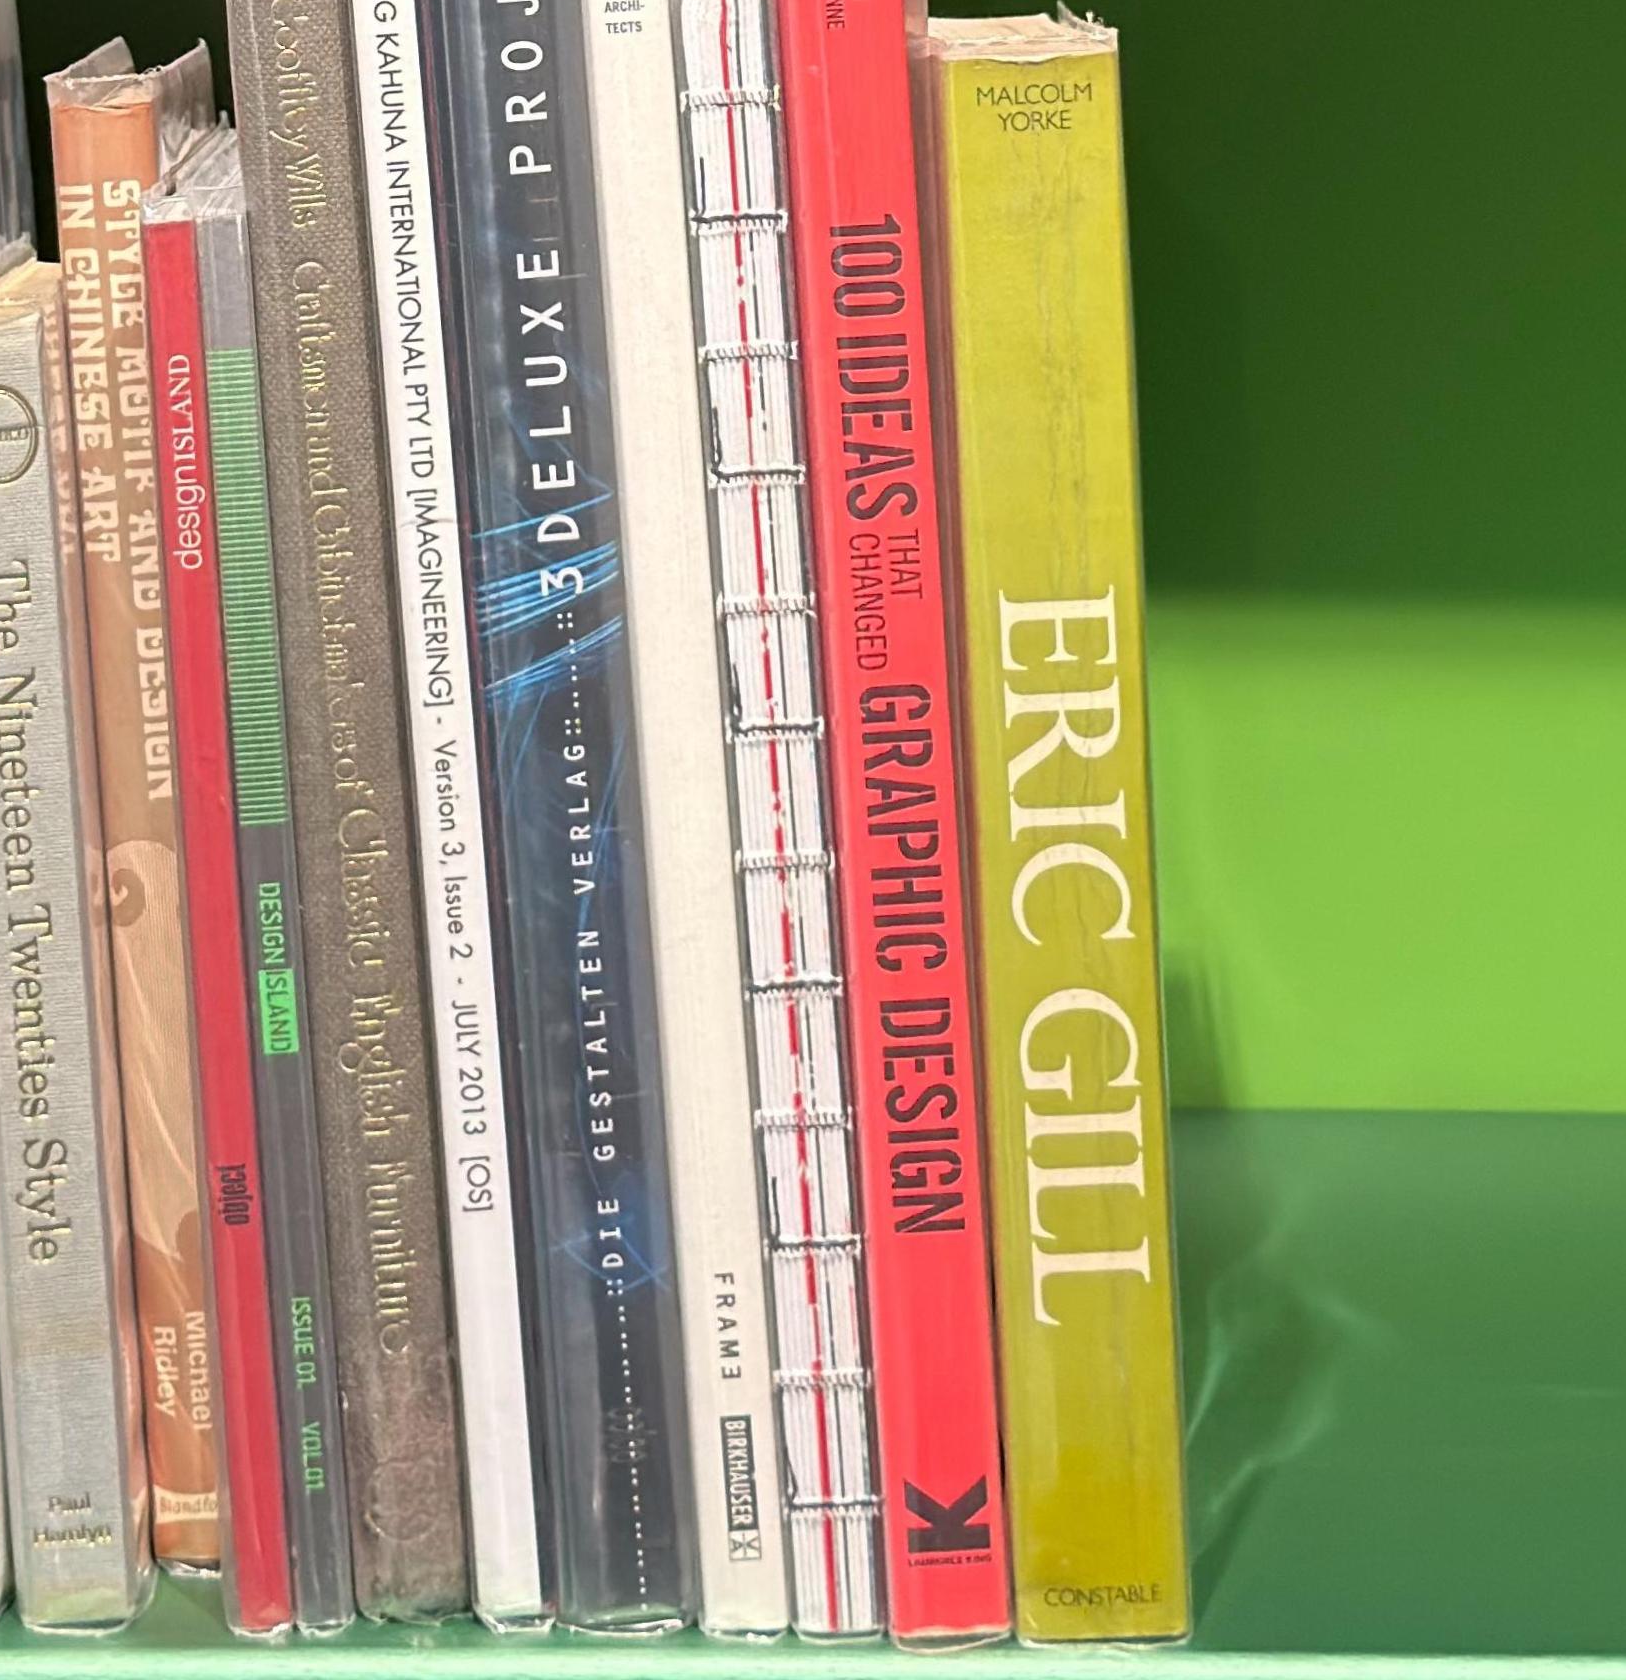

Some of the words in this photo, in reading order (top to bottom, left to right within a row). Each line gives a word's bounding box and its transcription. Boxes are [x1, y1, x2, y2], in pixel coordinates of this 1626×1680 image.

[604, 0, 646, 14] ARCHI-
[605, 20, 643, 35] TECTS
[374, 32, 409, 154] KAHUNA
[976, 82, 1093, 107] MALCOLM
[997, 108, 1074, 133] YORKE
[58, 183, 96, 230] IN
[284, 153, 329, 231] Wills
[385, 159, 427, 377] INTERNATIONAL
[829, 212, 906, 320] 100
[64, 245, 115, 454] CHINESE
[290, 259, 339, 430] Craftsmen
[102, 179, 146, 330] STYLE
[129, 507, 162, 611] AND
[404, 383, 432, 427] PTY
[515, 249, 586, 599] 3DELUXE
[836, 332, 919, 524] IDEAS
[307, 433, 349, 498] and
[408, 436, 436, 478] LTD
[81, 465, 121, 564] ART
[406, 488, 454, 709] [IMAGINEERING]
[848, 531, 889, 673] CHANGED
[888, 527, 924, 600] THAT
[331, 756, 376, 797] of
[433, 739, 461, 831] Version
[997, 581, 1138, 950] ERIC
[439, 840, 467, 866] 3,
[562, 743, 594, 897] VERLAG
[858, 681, 949, 974] GRAPHIC
[258, 881, 286, 965] DESIGN
[336, 806, 392, 967] Classic
[443, 874, 469, 935] Issue
[450, 943, 474, 959] 2
[6, 901, 57, 1124] Twenties
[265, 970, 292, 1053] ISLAND
[451, 999, 482, 1059] JULY
[578, 930, 616, 1163] GESTALTEN
[336, 989, 412, 1141] English
[458, 1066, 488, 1136] 2013
[880, 996, 966, 1235] DESIGN
[1018, 985, 1154, 1330] GILL
[15, 1137, 72, 1265] Style
[458, 1154, 494, 1214] [OS]
[363, 1159, 420, 1359] Furniture
[596, 1198, 624, 1269] DIE
[153, 1326, 180, 1418] Ridley
[291, 1296, 315, 1356] ISSUE
[47, 1491, 92, 1513] Paul
[1044, 1584, 1162, 1607] CONSTABLE
